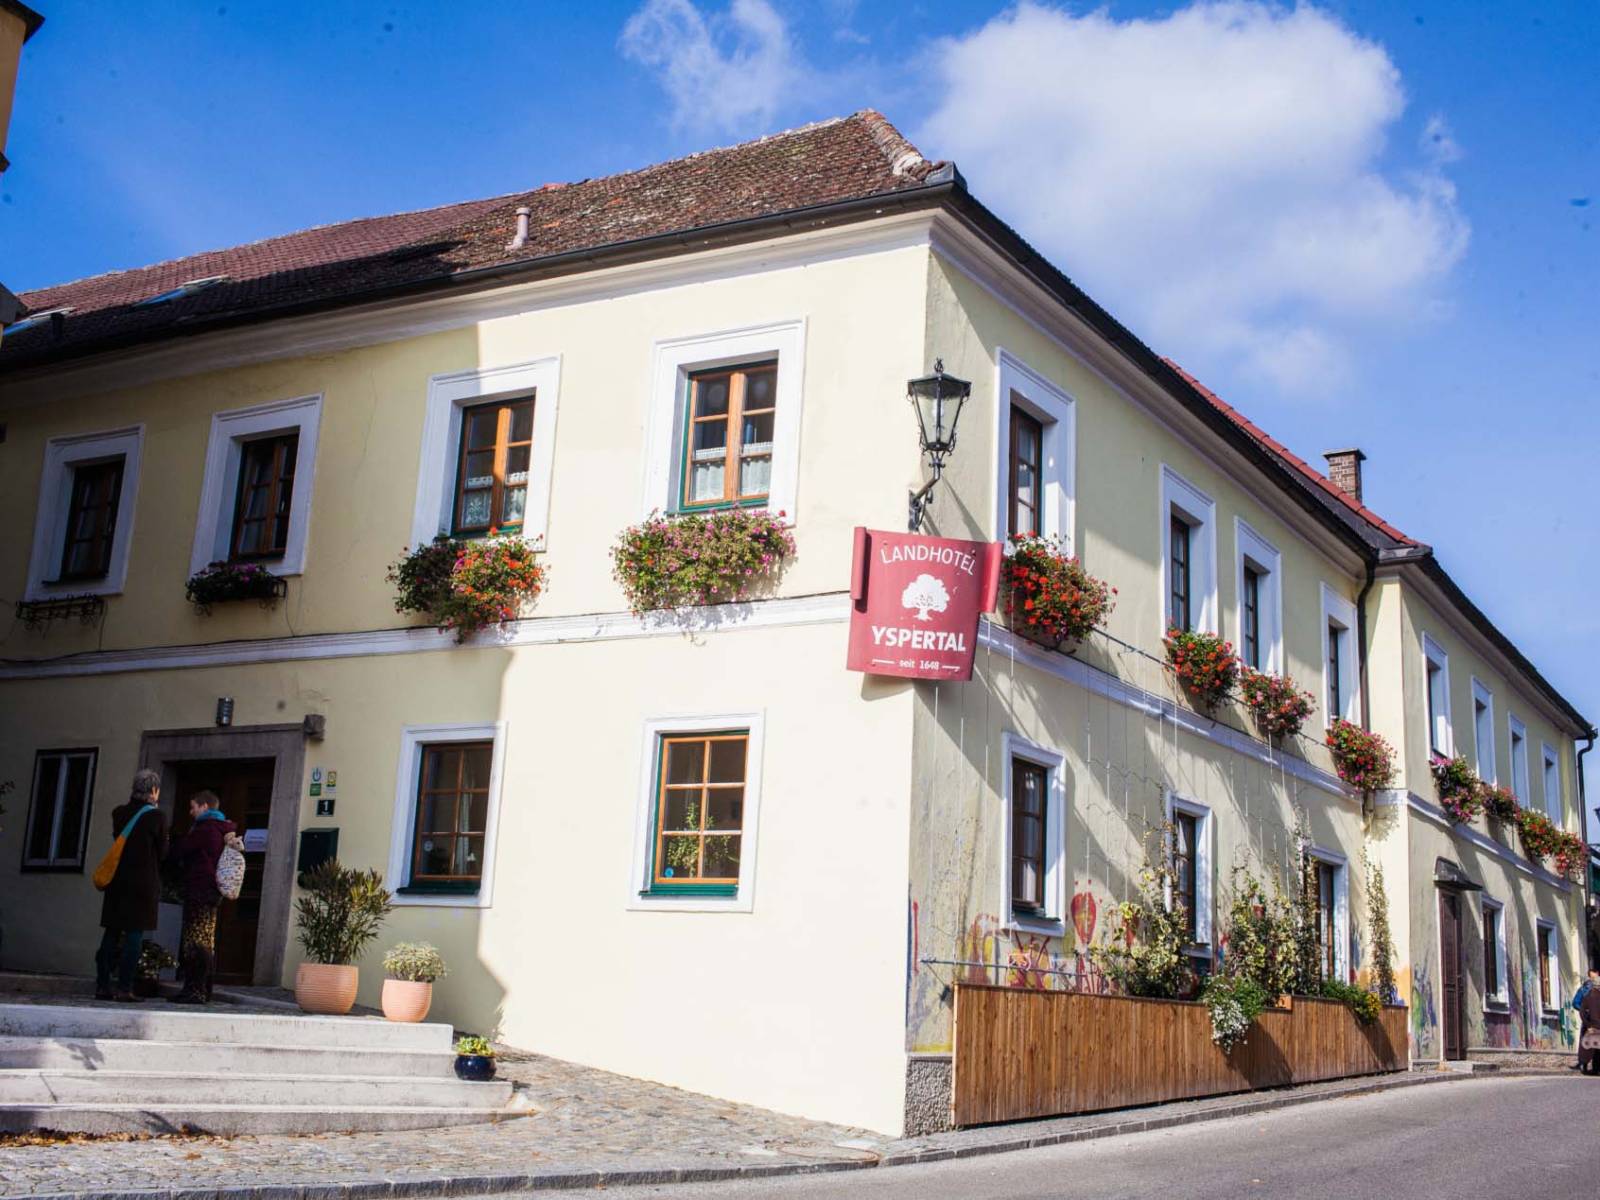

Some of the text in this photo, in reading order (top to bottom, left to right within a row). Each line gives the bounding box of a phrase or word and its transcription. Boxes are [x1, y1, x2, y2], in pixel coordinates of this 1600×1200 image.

[880, 544, 976, 576] LANDHOTEL
[871, 626, 966, 652] YSPERTAL
[899, 659, 915, 669] seit
[323, 800, 329, 811] 1
